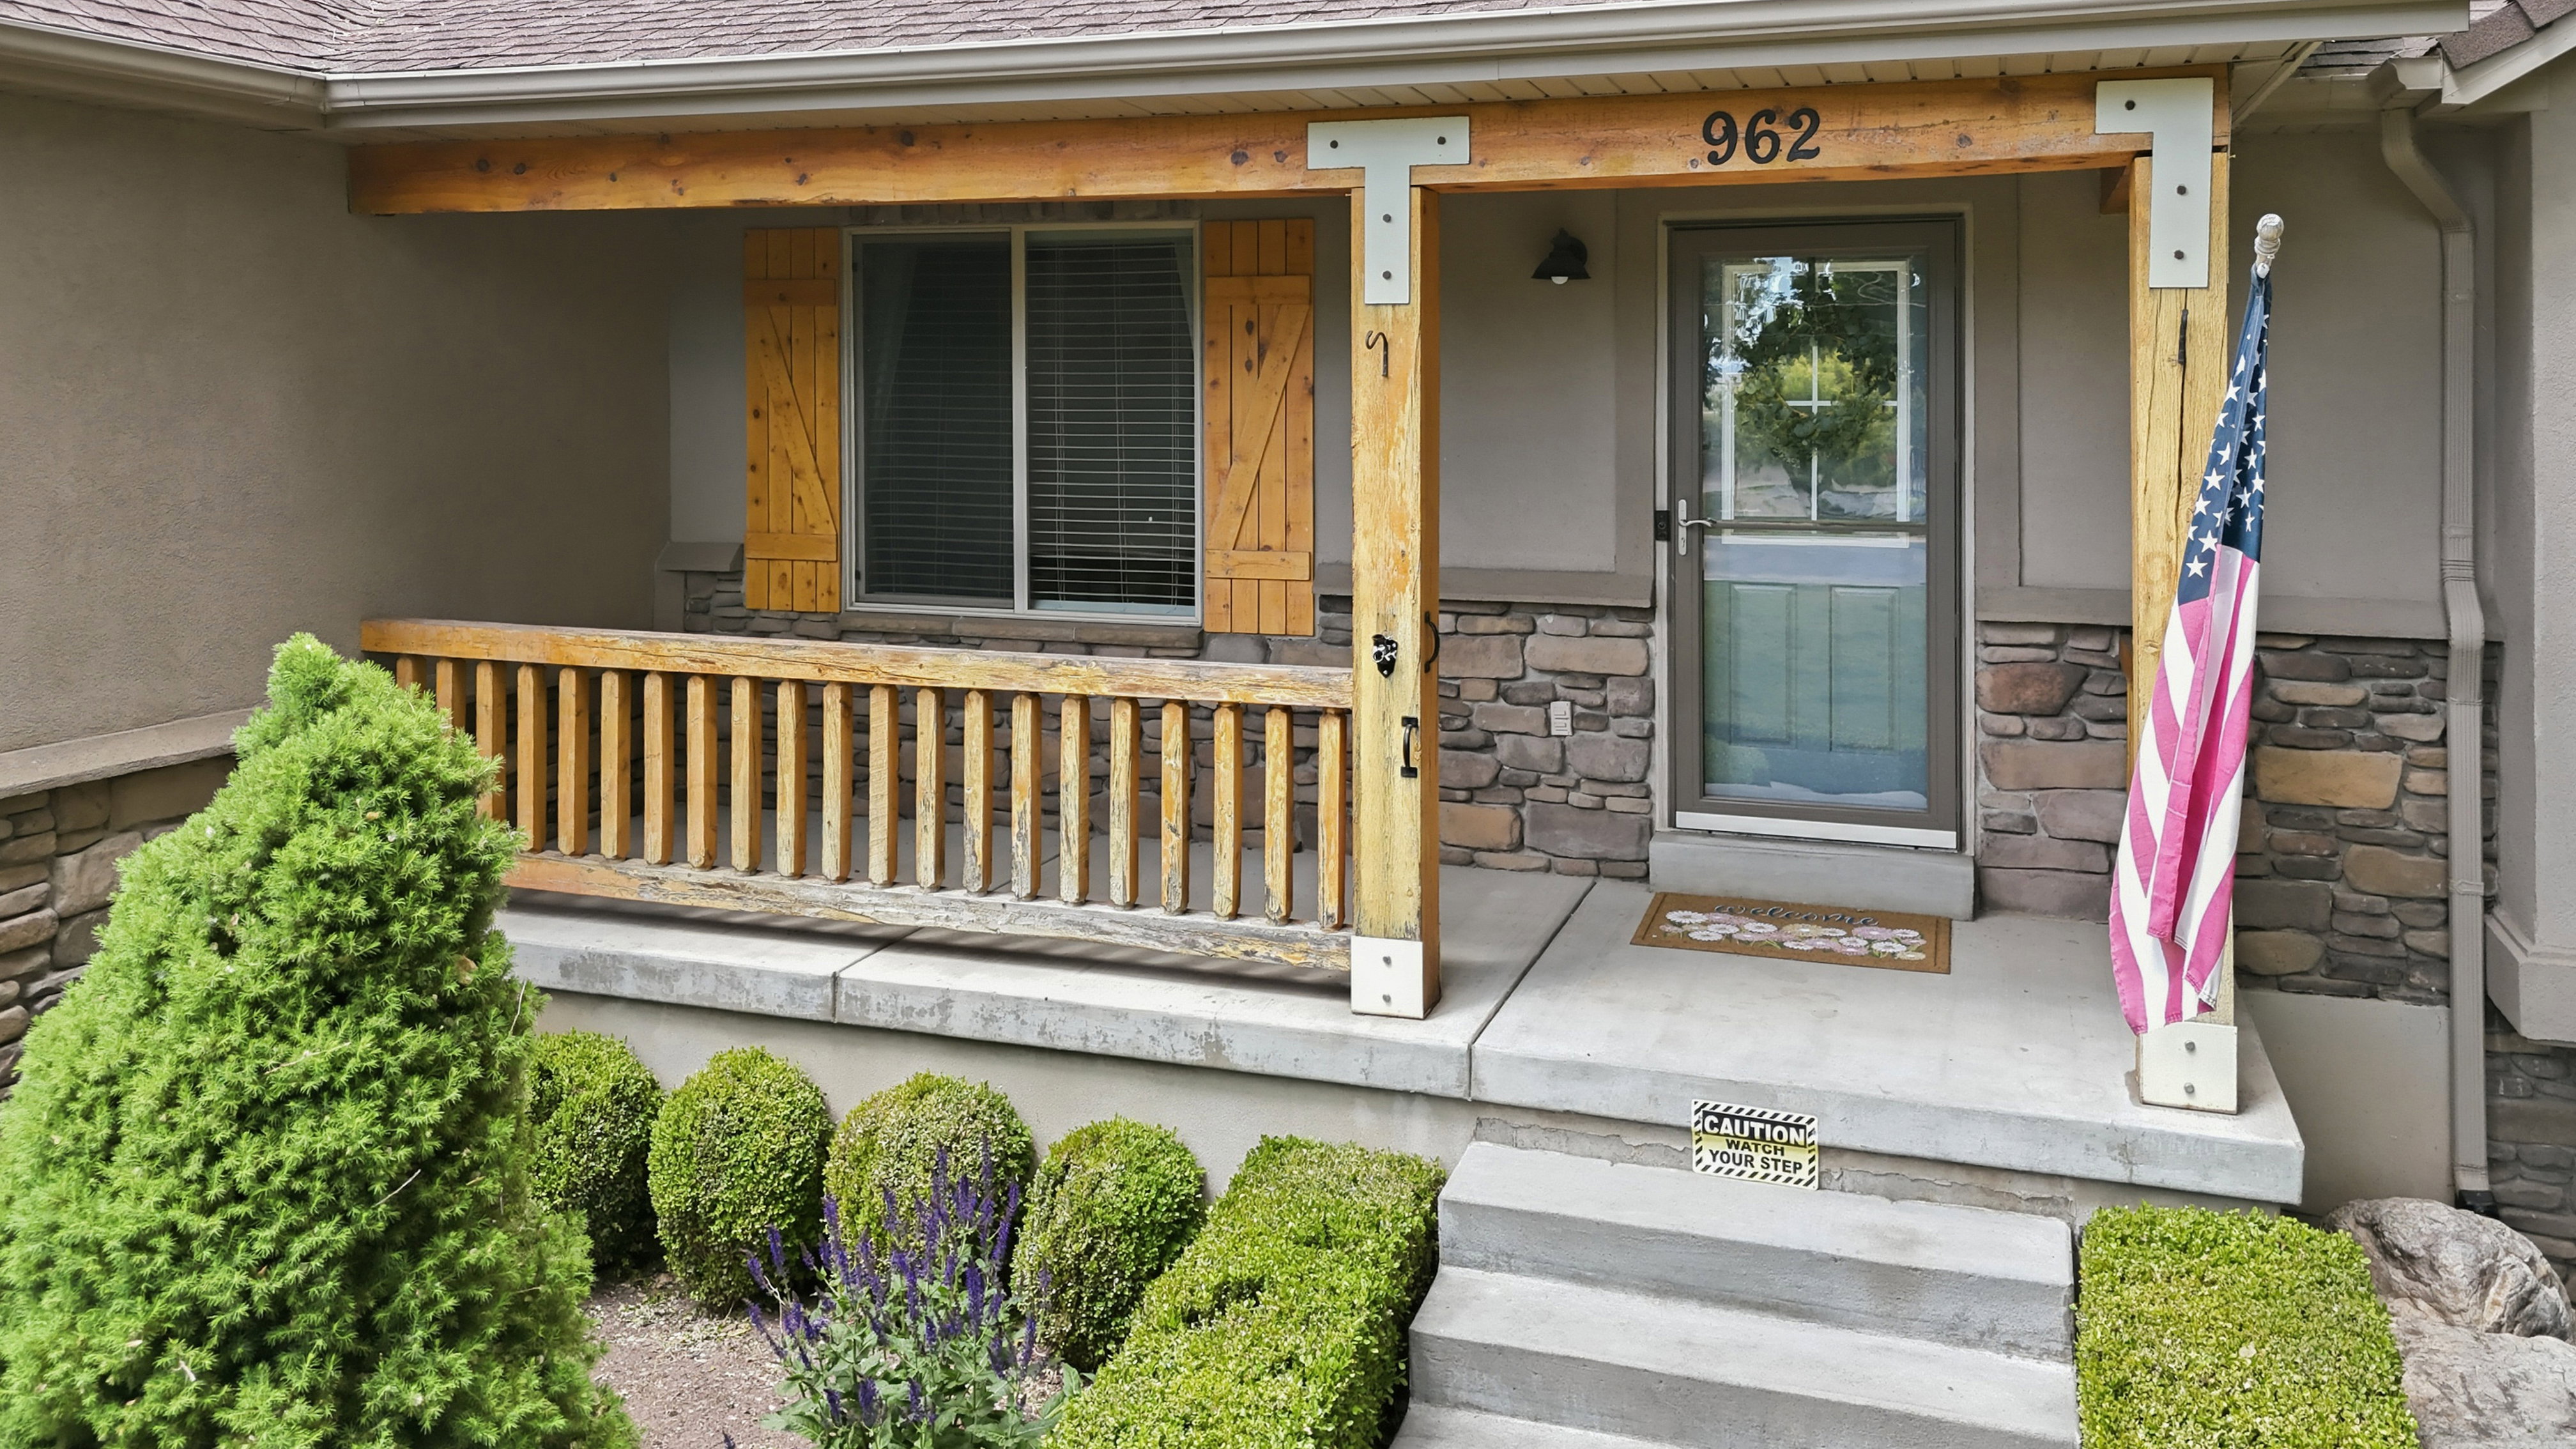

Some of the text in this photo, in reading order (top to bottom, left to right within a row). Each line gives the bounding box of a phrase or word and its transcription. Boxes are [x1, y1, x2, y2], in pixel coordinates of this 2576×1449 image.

[1703, 107, 1820, 165] 962
[1714, 905, 1879, 926] welcome
[1703, 1115, 1805, 1146] CAUTION
[1726, 1138, 1784, 1156] WATCH
[1709, 1149, 1802, 1174] YOUR STEP
